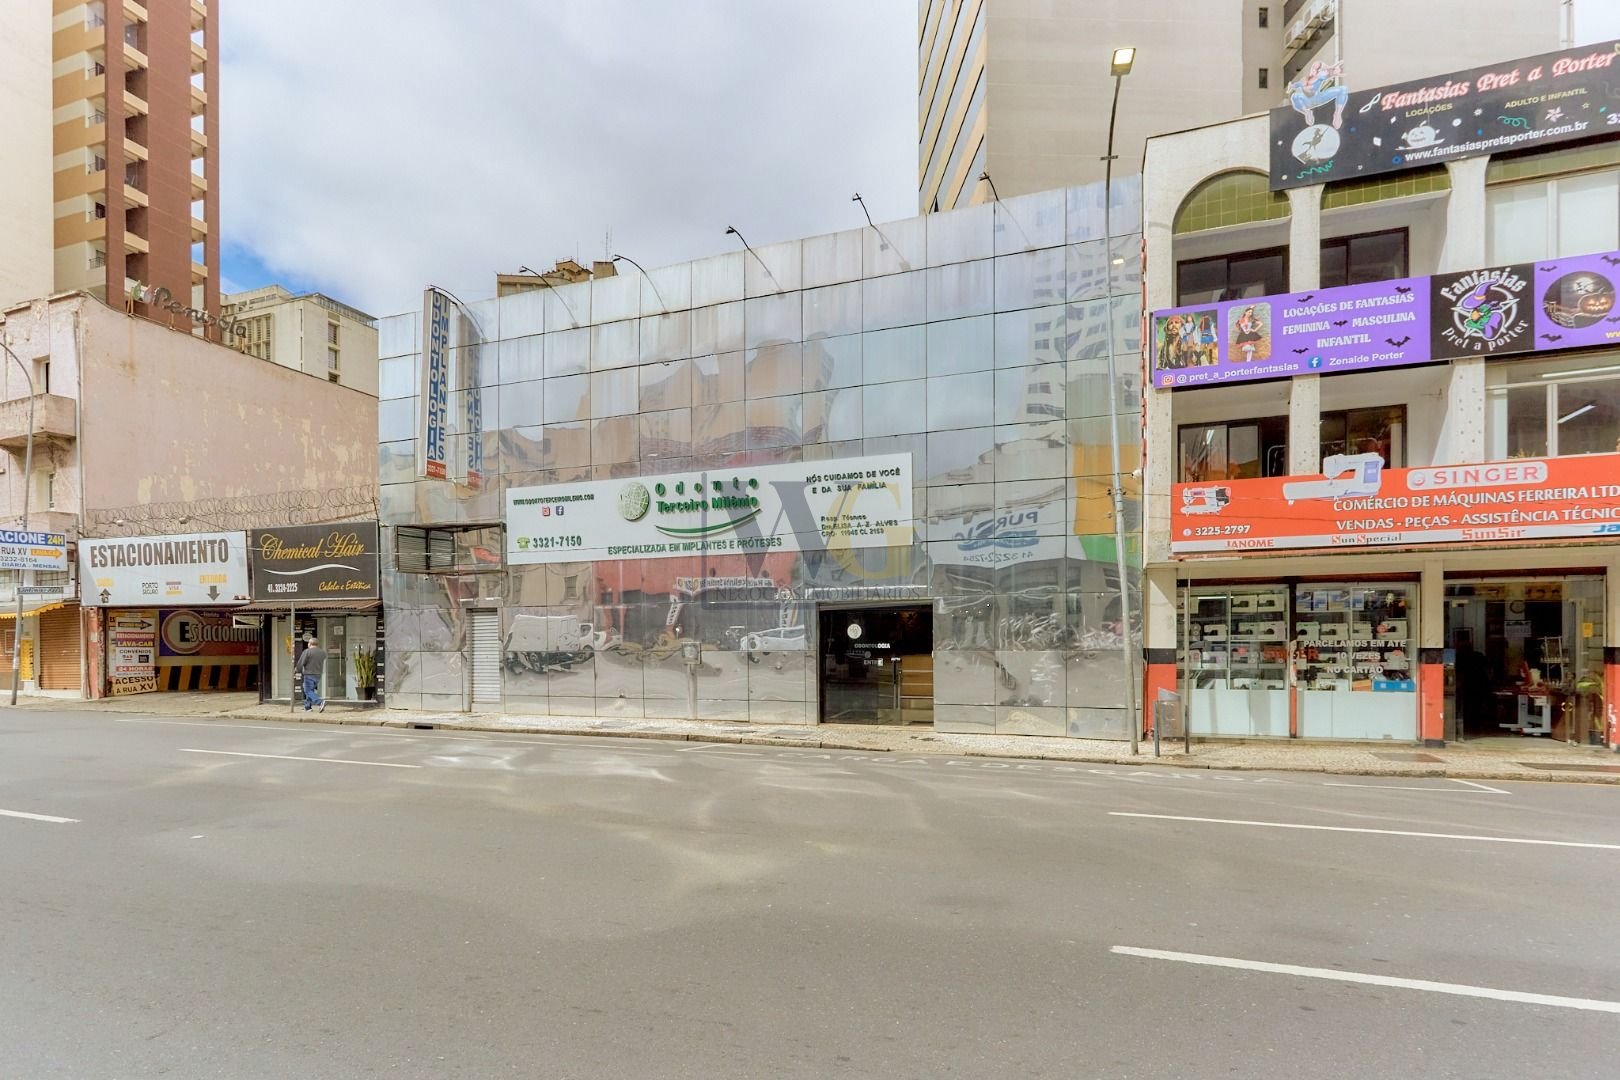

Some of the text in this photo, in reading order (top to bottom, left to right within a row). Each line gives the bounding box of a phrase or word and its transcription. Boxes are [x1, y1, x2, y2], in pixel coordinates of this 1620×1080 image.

[1381, 51, 1617, 111] Fantasias Pret a Porter
[1405, 102, 1453, 118] LOCAÇÕES
[1505, 96, 1539, 109] ADULTO
[1548, 88, 1588, 100] INFANTIL
[1405, 121, 1589, 162] www.fantasiaspretaporter.com.br
[1440, 267, 1528, 302] Fantasias
[1283, 293, 1415, 318] LOCAÇÕES DE FANTASIAS
[1282, 312, 1416, 335] FEMININA MASCULINA
[1317, 334, 1371, 348] INFANTIL
[1329, 352, 1404, 366] Zenaide Porter
[427, 293, 440, 459] ODONTOLOGIA
[438, 298, 448, 461] IMPLANTES
[806, 467, 901, 483] NÓS CUIDAMOS DE VOCÊ
[1434, 466, 1539, 484] SINGER
[837, 484, 852, 492] SUA
[857, 481, 887, 490] FAMÍLIA
[656, 499, 709, 513] Terceiro
[1334, 496, 1408, 511] COMÉRCIO
[1411, 495, 1430, 507] DE
[1433, 491, 1515, 508] MÁQUINAS
[1518, 487, 1588, 502] FERREIRA
[1336, 518, 1394, 530] VENDAS
[1405, 515, 1450, 529] PEÇAS
[1460, 509, 1559, 525] ASSISTÊNCIA
[47, 534, 64, 545] 24H
[1195, 525, 1251, 536] 3225-2797
[260, 531, 364, 560] Chemical Hair
[532, 536, 582, 548] 3321-7150
[608, 537, 782, 555] ESPECIALIZADA EM IMPLANTES E PRÓTESES
[18, 547, 27, 556] XV
[90, 538, 229, 568] ESTACIONAMENTO
[115, 676, 154, 685] ACESSO
[139, 683, 154, 691] XV
